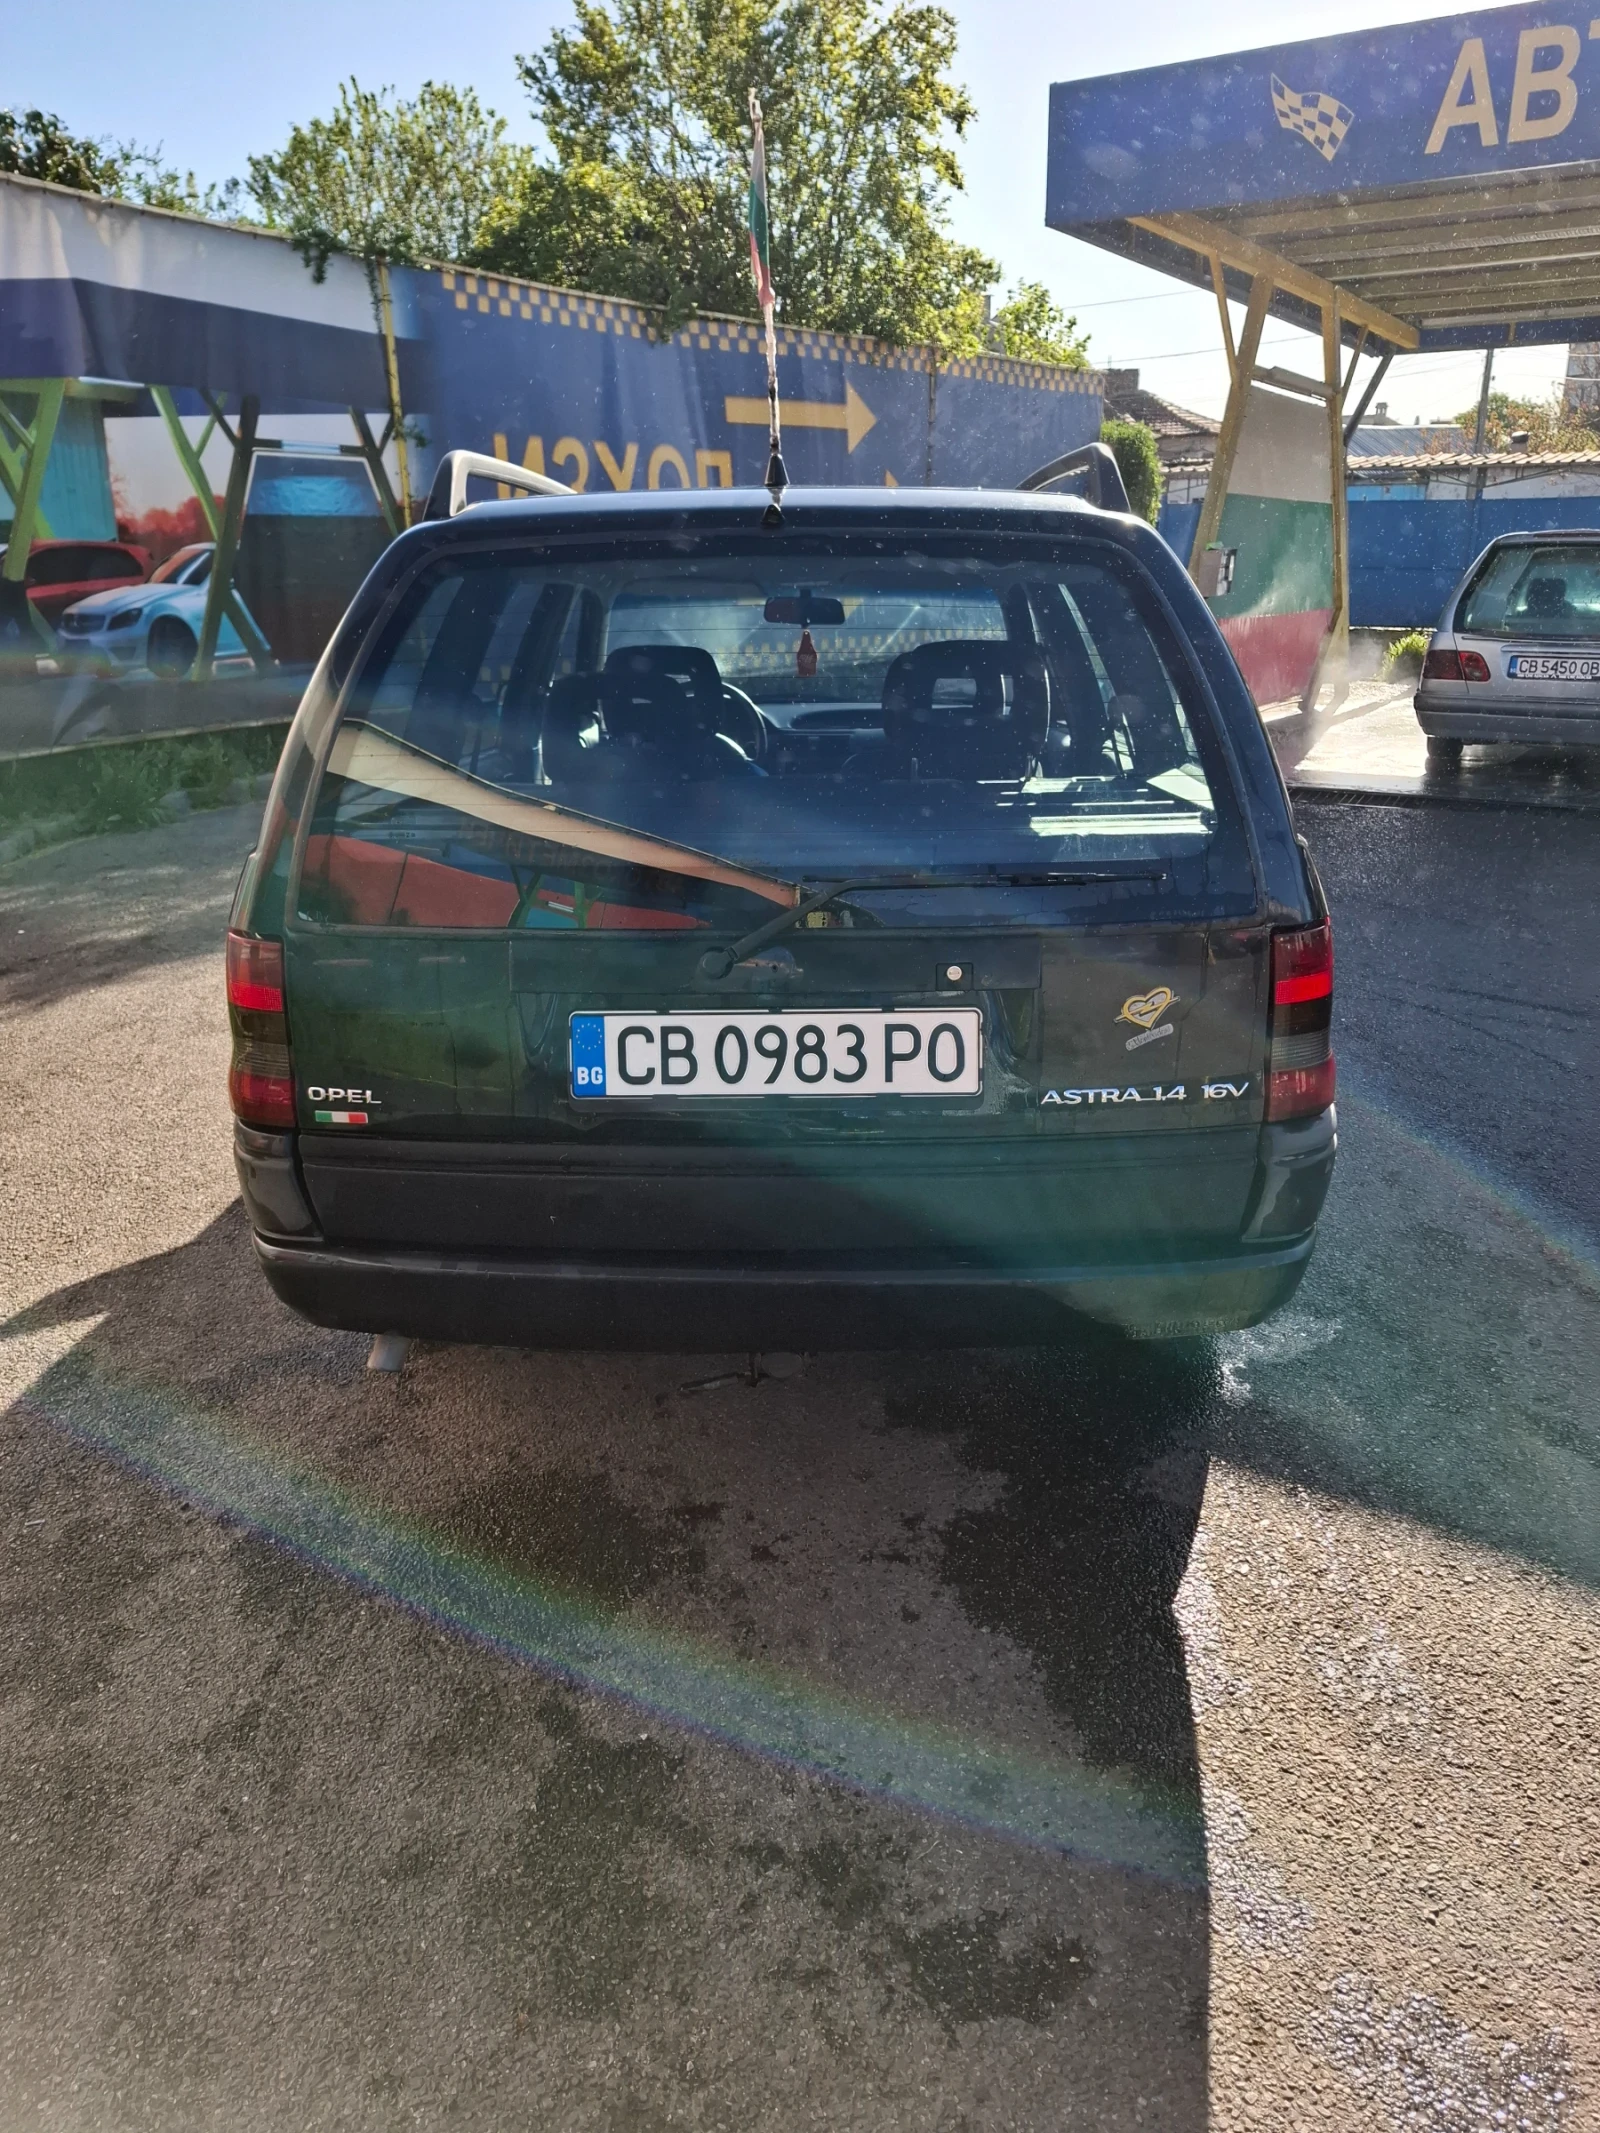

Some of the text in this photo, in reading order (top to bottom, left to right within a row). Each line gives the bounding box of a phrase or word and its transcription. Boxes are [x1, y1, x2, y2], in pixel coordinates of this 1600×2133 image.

[1424, 20, 1600, 154] АВ
[1541, 660, 1577, 674] 5450
[617, 1023, 966, 1085] CB 0983 PO
[576, 1067, 603, 1085] BG
[308, 1086, 383, 1104] OPEL
[1041, 1087, 1142, 1104] ASTRA
[1201, 1082, 1249, 1099] 16V
